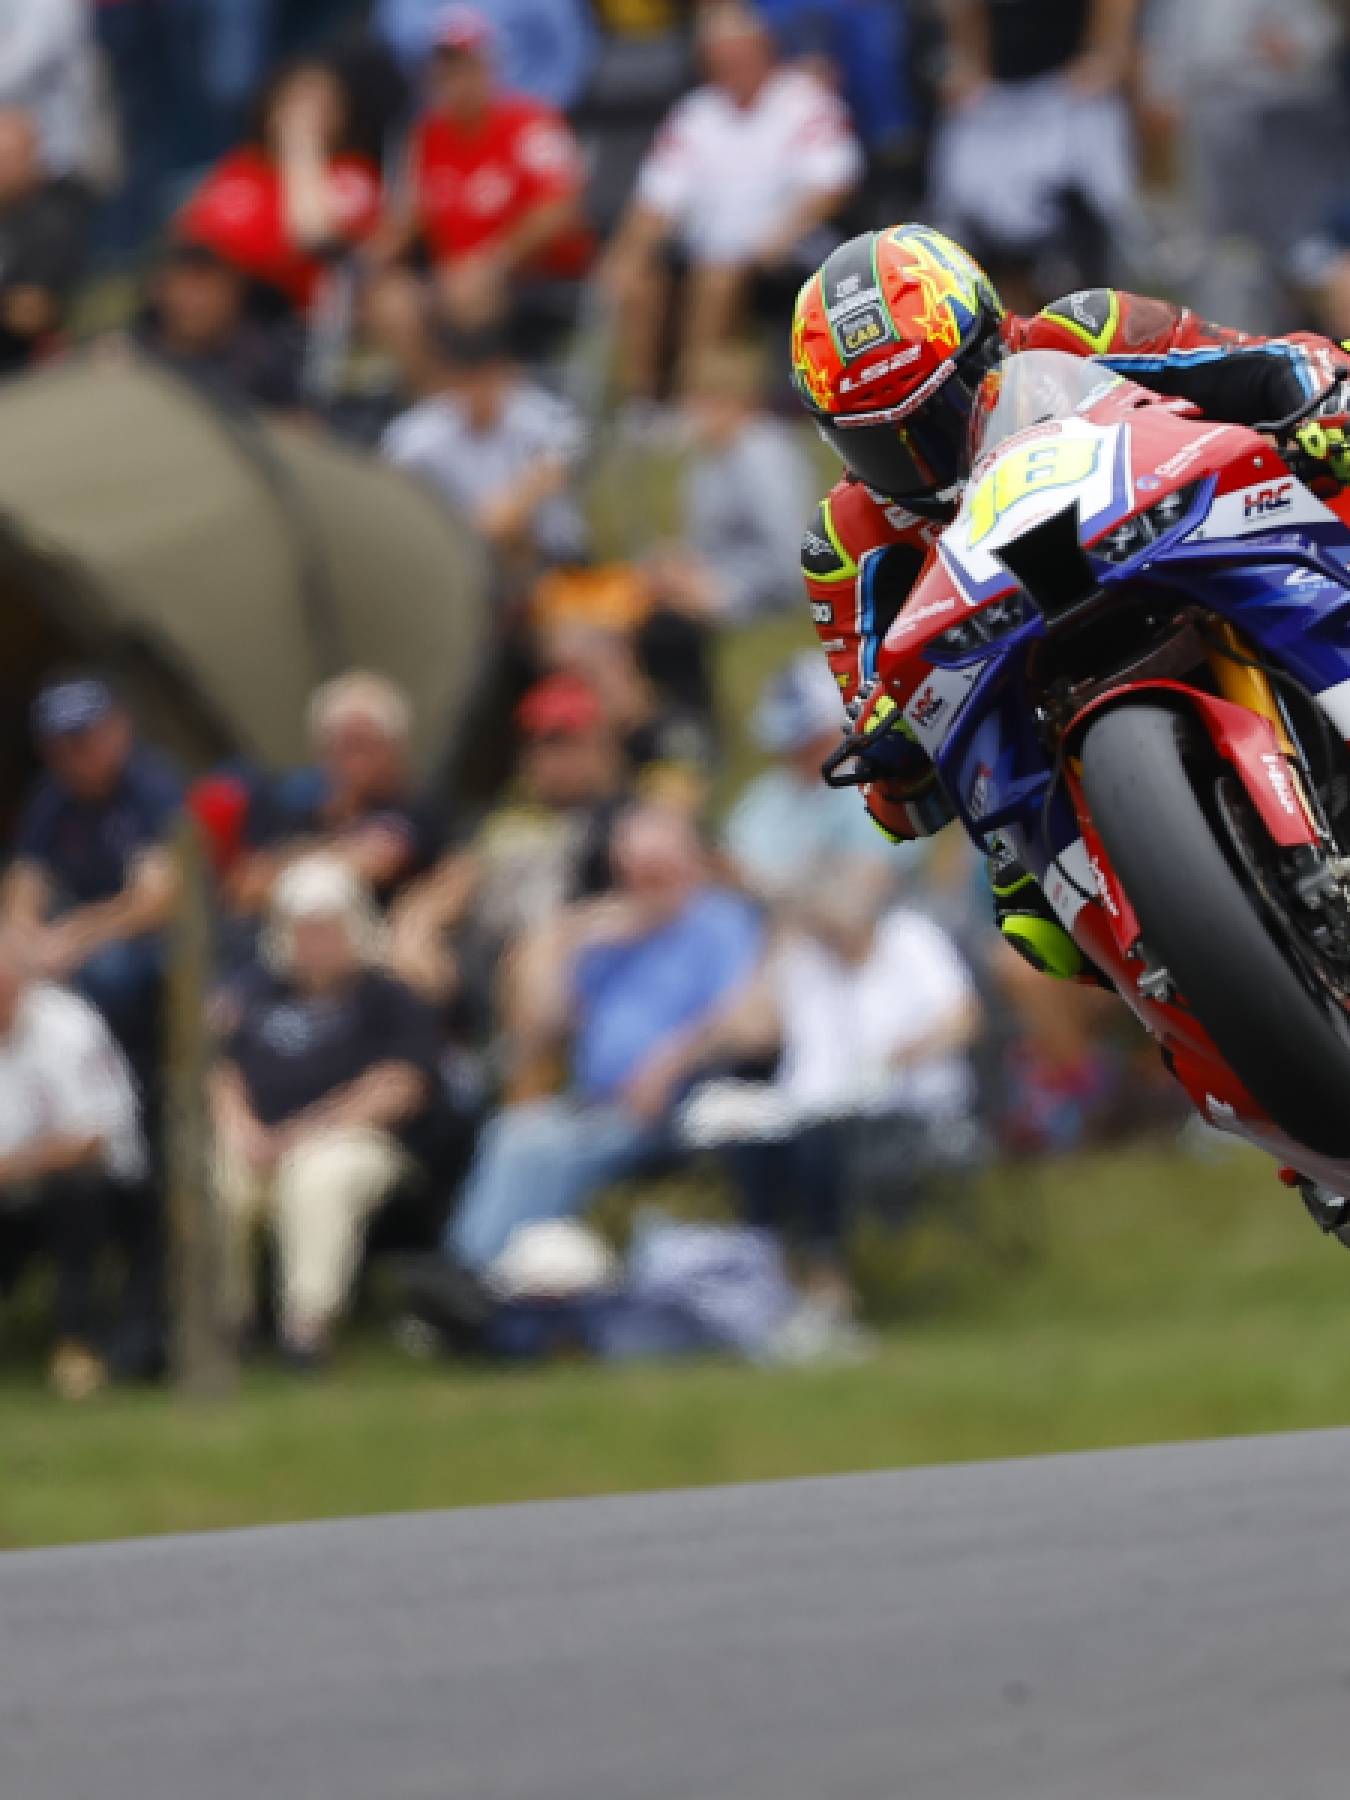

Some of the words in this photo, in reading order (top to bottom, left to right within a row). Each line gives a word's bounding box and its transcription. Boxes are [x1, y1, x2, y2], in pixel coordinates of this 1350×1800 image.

[845, 323, 880, 349] CAB
[839, 344, 922, 394] LS2
[967, 437, 1105, 553] 18
[1242, 482, 1293, 517] HRC
[911, 686, 944, 727] HRC
